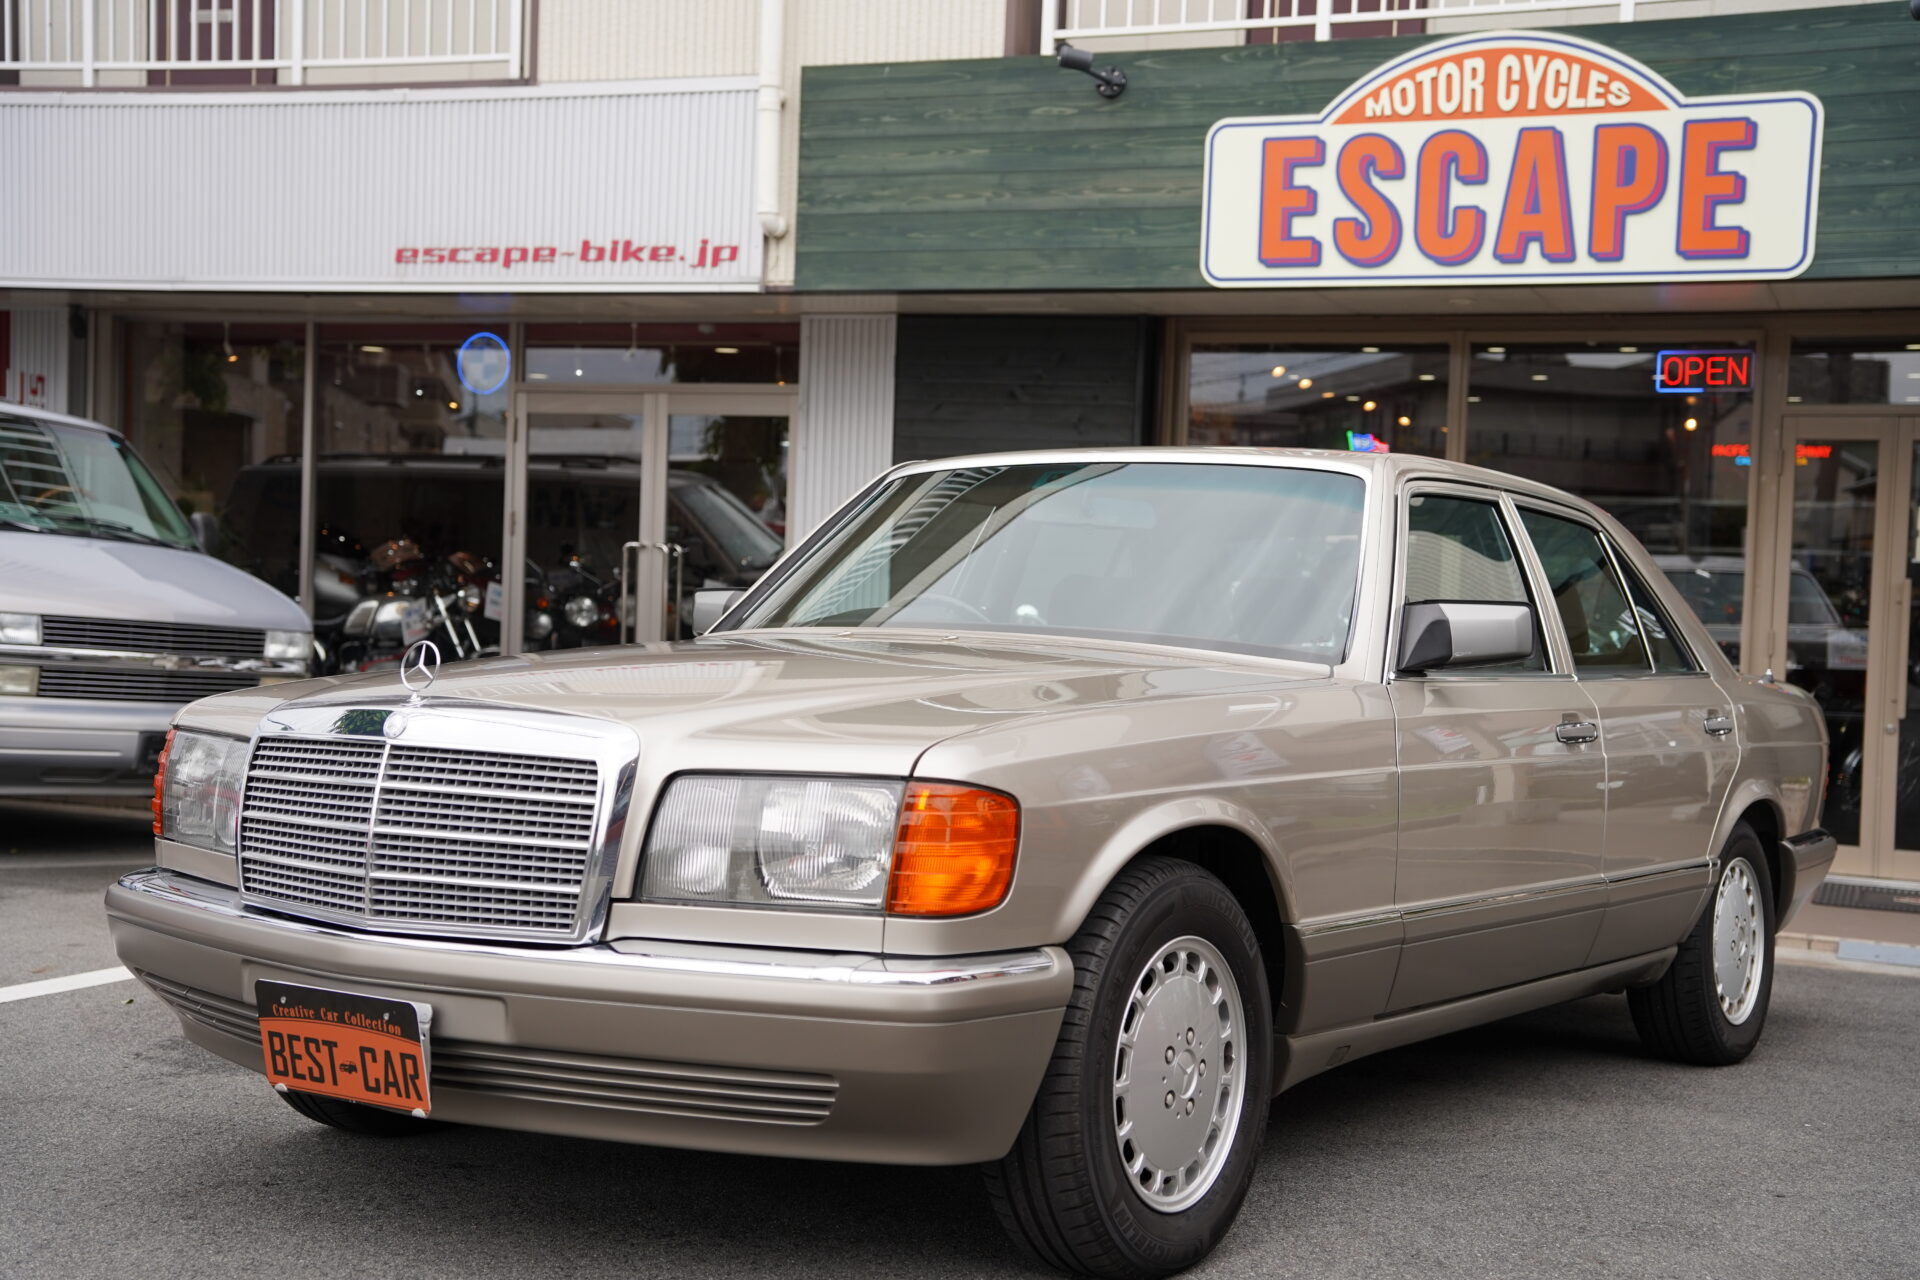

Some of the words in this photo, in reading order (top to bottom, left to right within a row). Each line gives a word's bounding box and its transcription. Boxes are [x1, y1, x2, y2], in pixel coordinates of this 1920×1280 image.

[1365, 57, 1485, 117] MOTOR
[1497, 54, 1631, 112] CYCLES
[1259, 117, 1757, 268] ESCAPE
[395, 240, 739, 268] escape-bike.jp
[1663, 356, 1748, 386] OPEN
[272, 1004, 315, 1018] Creative
[321, 1008, 338, 1021] Car
[344, 1011, 401, 1036] Collection
[267, 1030, 338, 1086] BEST
[359, 1046, 423, 1101] CAR
